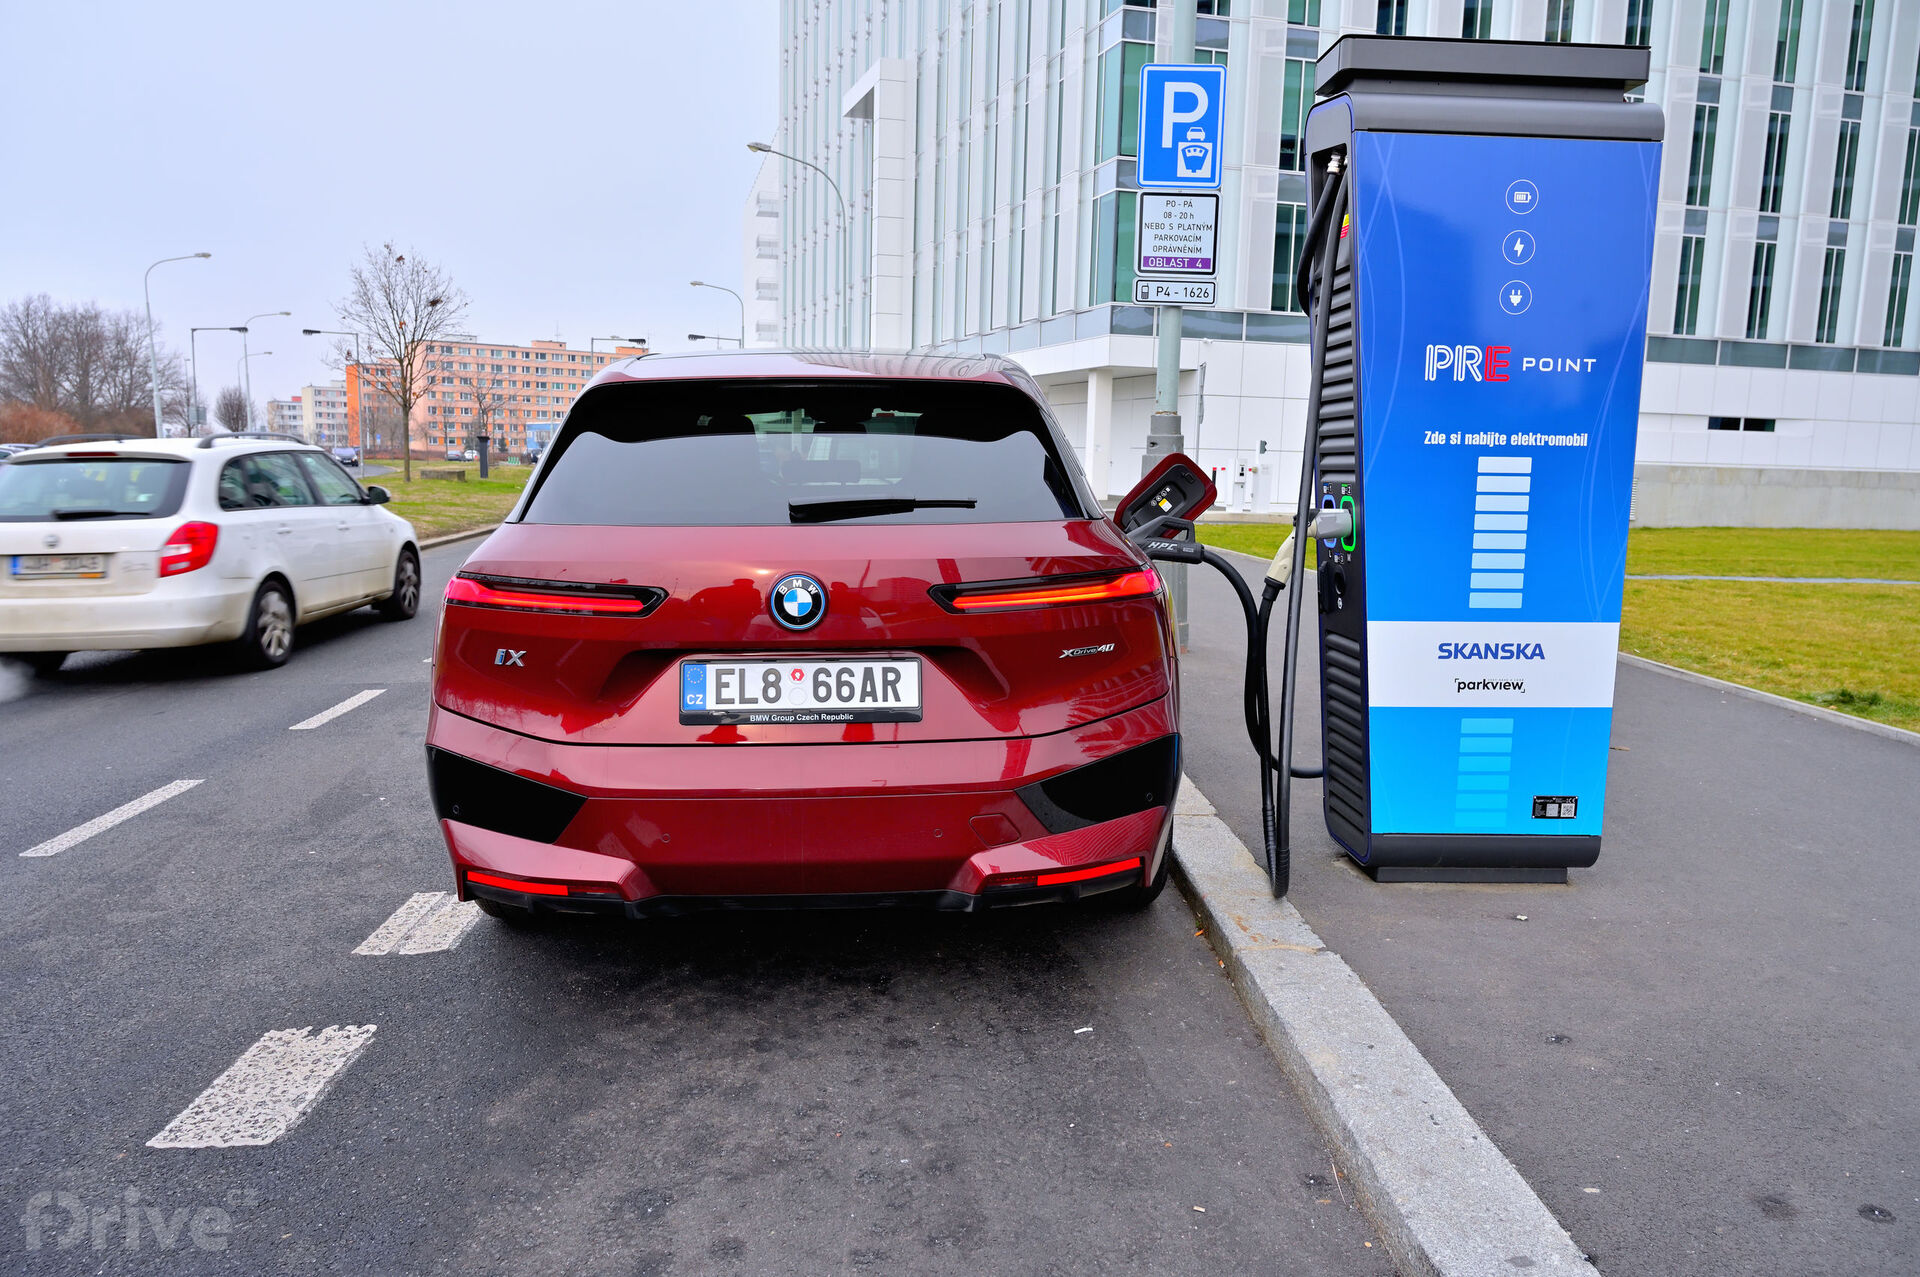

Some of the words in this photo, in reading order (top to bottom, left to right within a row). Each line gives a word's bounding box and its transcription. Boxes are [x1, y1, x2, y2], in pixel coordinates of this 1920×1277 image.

[1162, 81, 1209, 149] P
[1166, 200, 1176, 208] PO
[1183, 199, 1193, 208] PÁ
[1163, 211, 1172, 219] 08
[1179, 212, 1188, 220] 20
[1189, 212, 1194, 220] h
[1144, 222, 1165, 230] NEBO
[1177, 222, 1213, 231] PLATNÝM
[1154, 233, 1202, 243] PARKOVACÍM
[1152, 244, 1202, 254] OPRÁVNĚNÍM
[1148, 257, 1189, 268] OBLAST
[1195, 258, 1202, 268] 4
[1156, 286, 1170, 297] P4
[1183, 287, 1210, 298] 1626
[1424, 344, 1511, 382] PRE
[1522, 357, 1597, 372] POINT
[1424, 431, 1446, 445] Zde
[1450, 431, 1461, 445] si
[1465, 431, 1507, 447] nabijte
[1510, 432, 1588, 446] elektromobil
[1148, 541, 1177, 551] HPC
[778, 579, 818, 595] BMW
[1437, 642, 1546, 660] SKANSKA
[494, 648, 527, 667] iX
[715, 667, 782, 705] EL8
[812, 666, 902, 703] 66AR
[1457, 678, 1525, 694] parkview
[686, 694, 704, 705] CZ
[750, 714, 769, 722] BMW
[771, 714, 794, 723] Group
[796, 713, 819, 721] Czech
[821, 712, 854, 722] Republic
